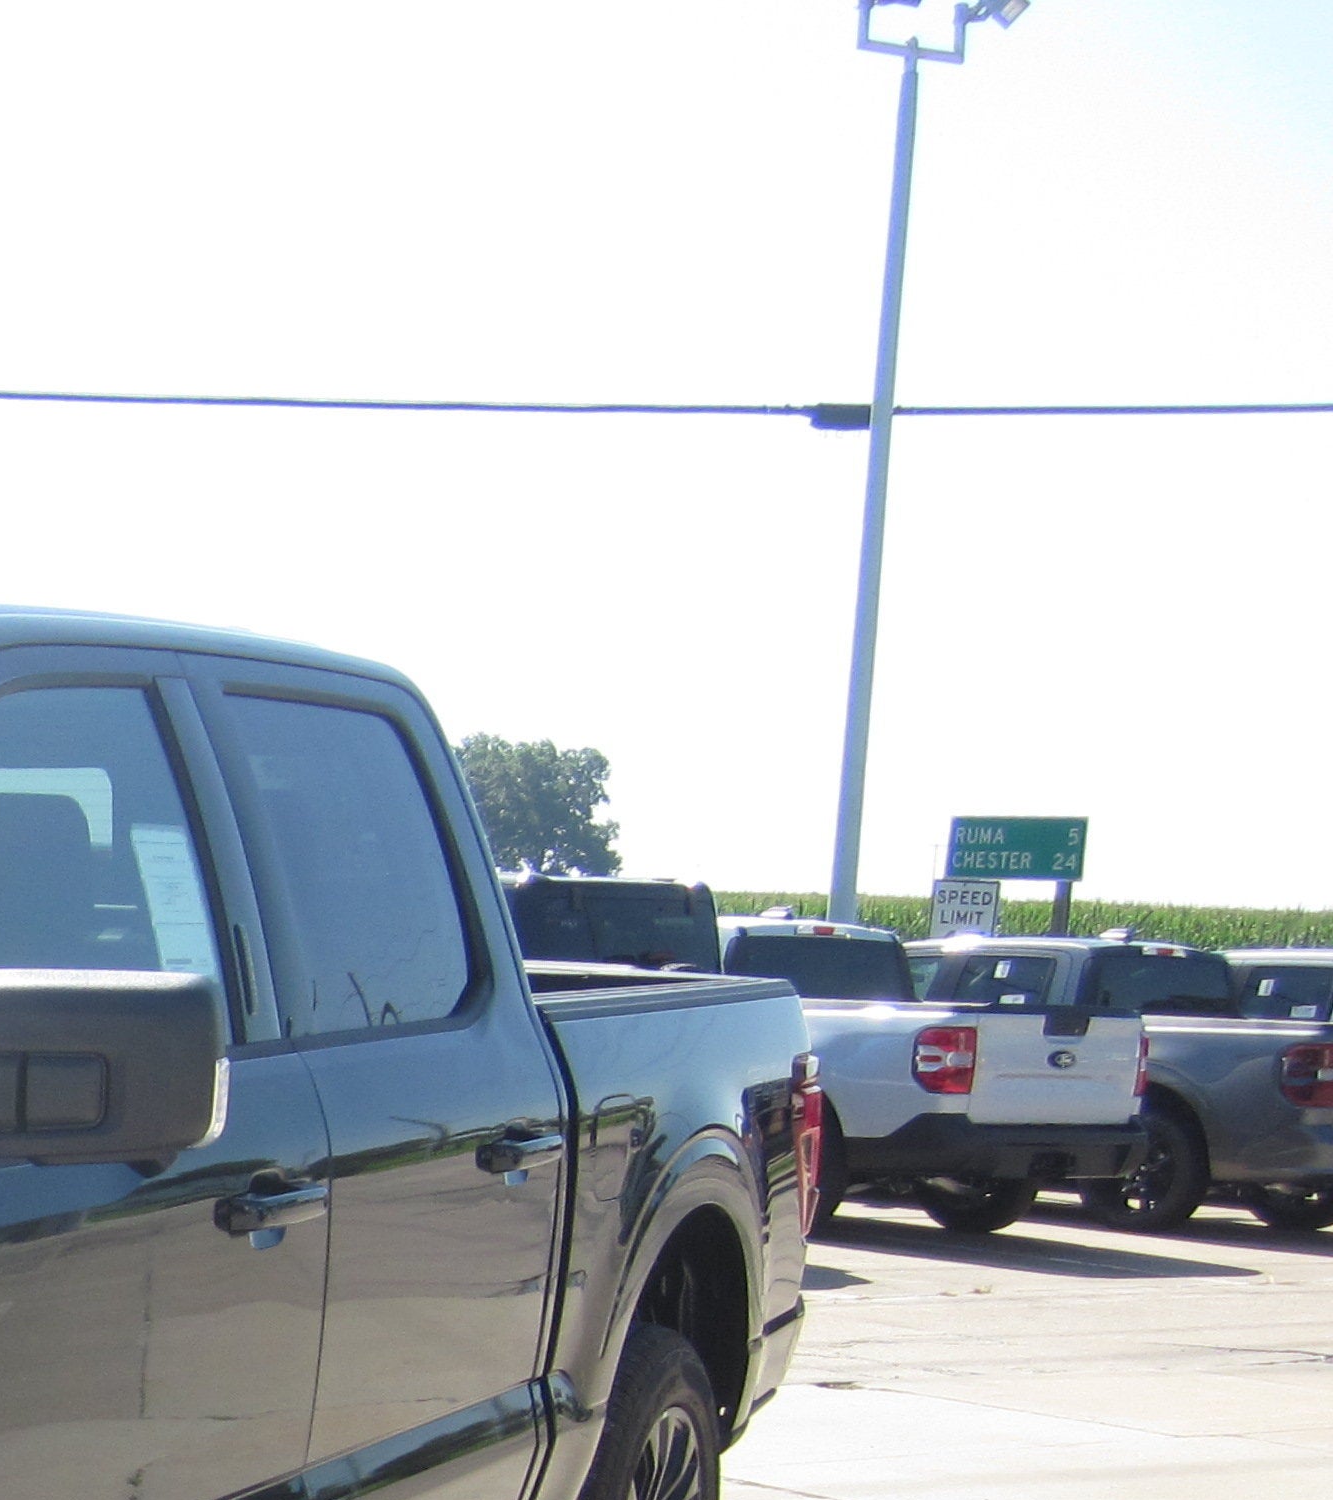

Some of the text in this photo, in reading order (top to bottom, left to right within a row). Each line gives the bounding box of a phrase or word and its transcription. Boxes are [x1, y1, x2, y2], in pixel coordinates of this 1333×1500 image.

[954, 827, 1080, 846] RUMA 5
[952, 851, 1077, 871] CHESTER 24
[937, 890, 993, 906] SPEED
[940, 911, 984, 925] LIMIT
